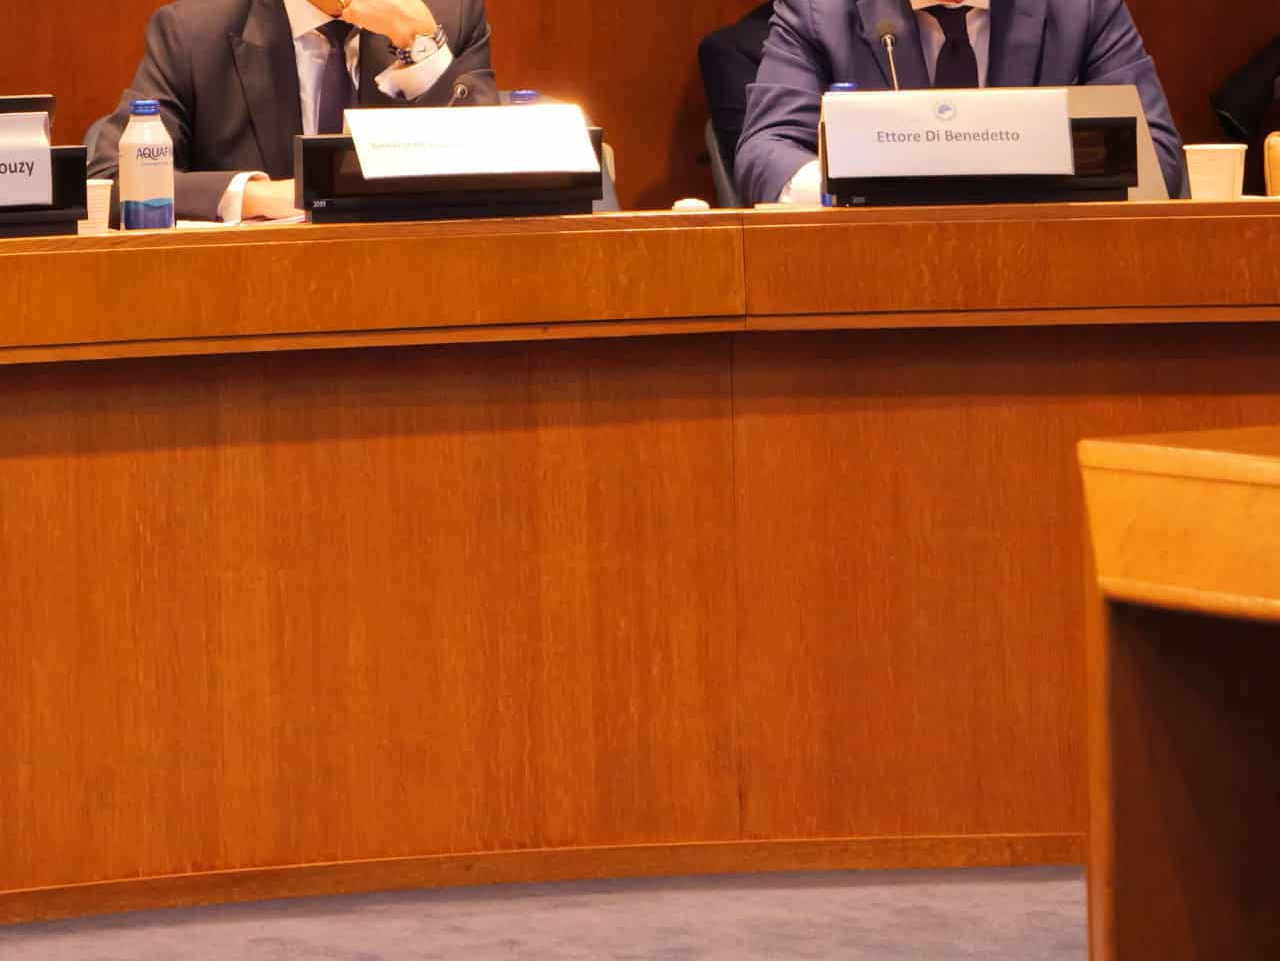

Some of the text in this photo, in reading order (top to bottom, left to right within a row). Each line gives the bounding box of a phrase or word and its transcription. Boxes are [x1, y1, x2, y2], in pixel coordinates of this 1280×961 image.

[876, 128, 1021, 143] Ettore Di Benedetto
